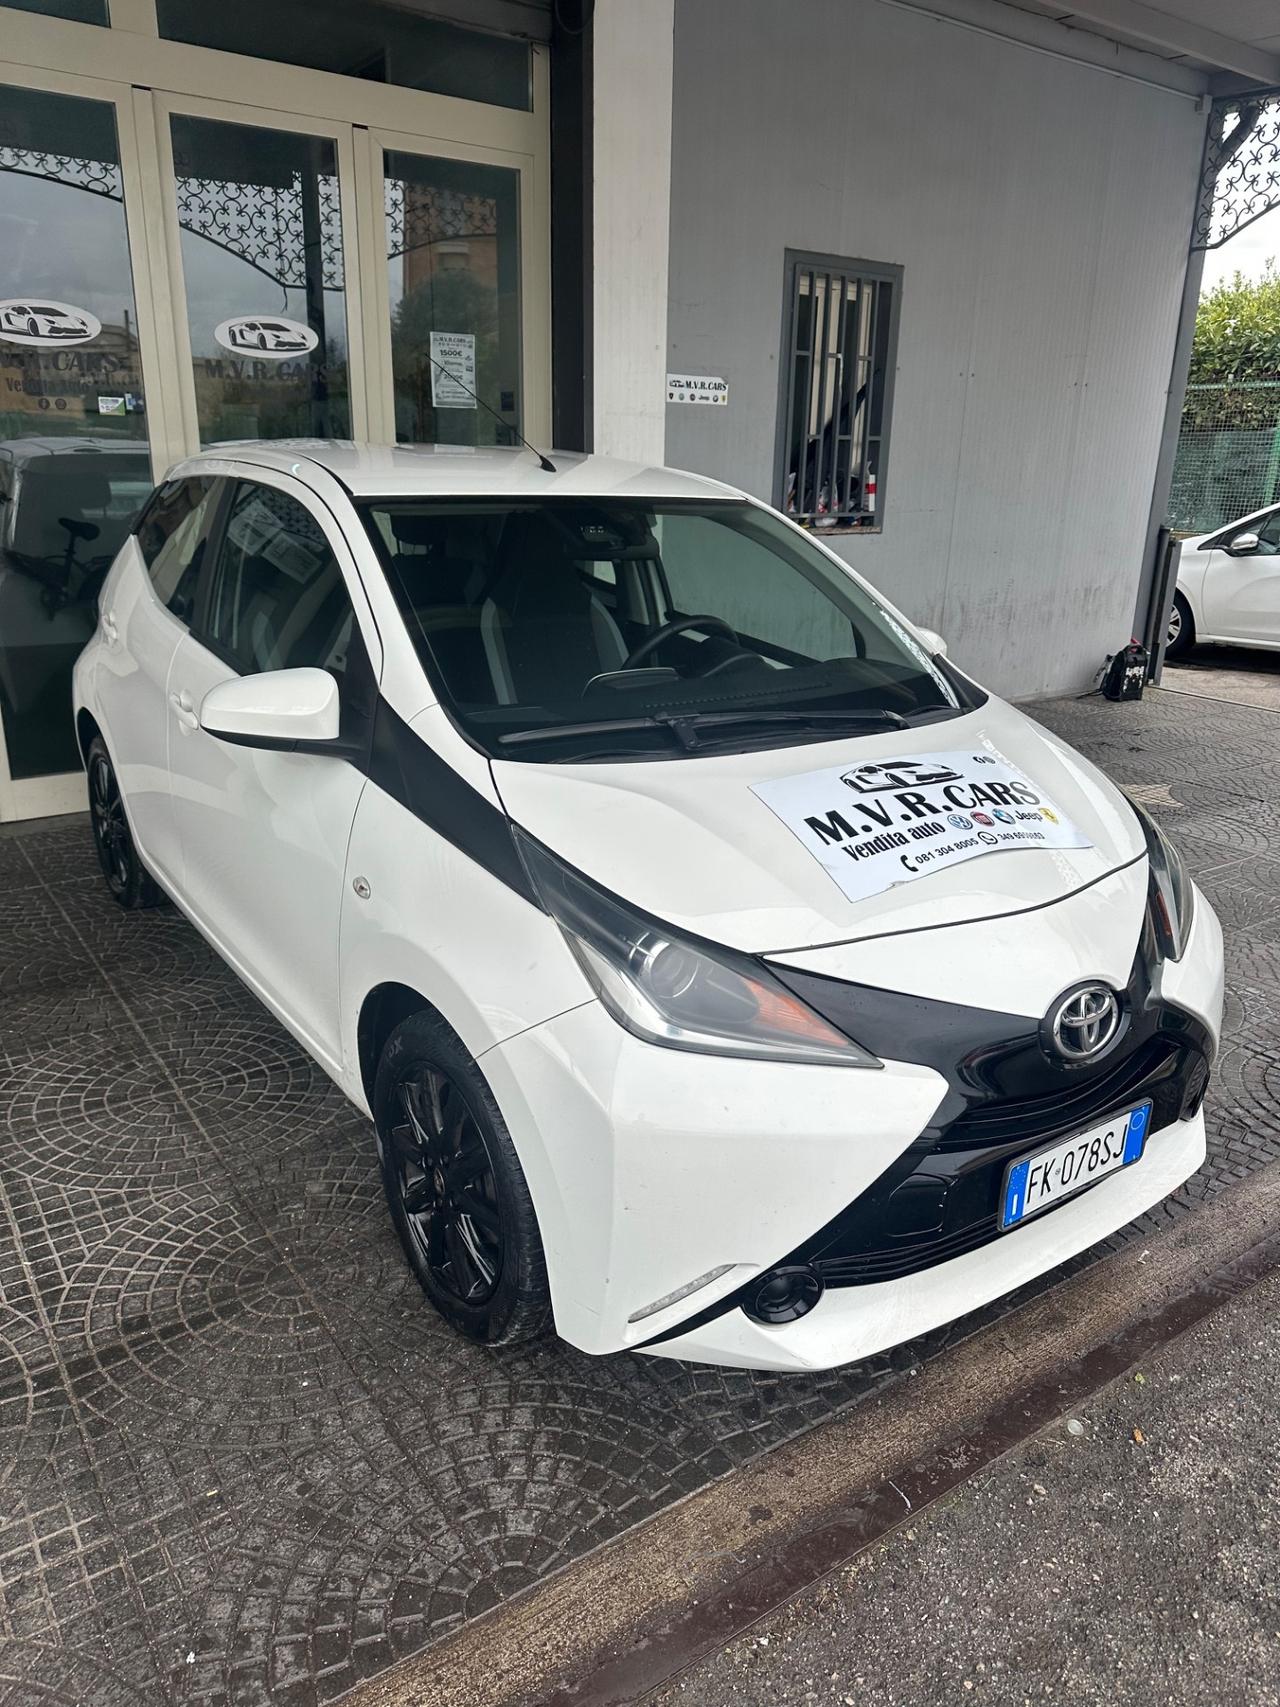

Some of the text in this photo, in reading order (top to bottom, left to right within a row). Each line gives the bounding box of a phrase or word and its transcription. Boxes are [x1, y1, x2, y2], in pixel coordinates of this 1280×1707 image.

[1015, 809, 1043, 823] Jeep
[841, 821, 946, 862] Vendita auto
[997, 832, 1015, 841] 349
[914, 837, 980, 865] 081 304 8005
